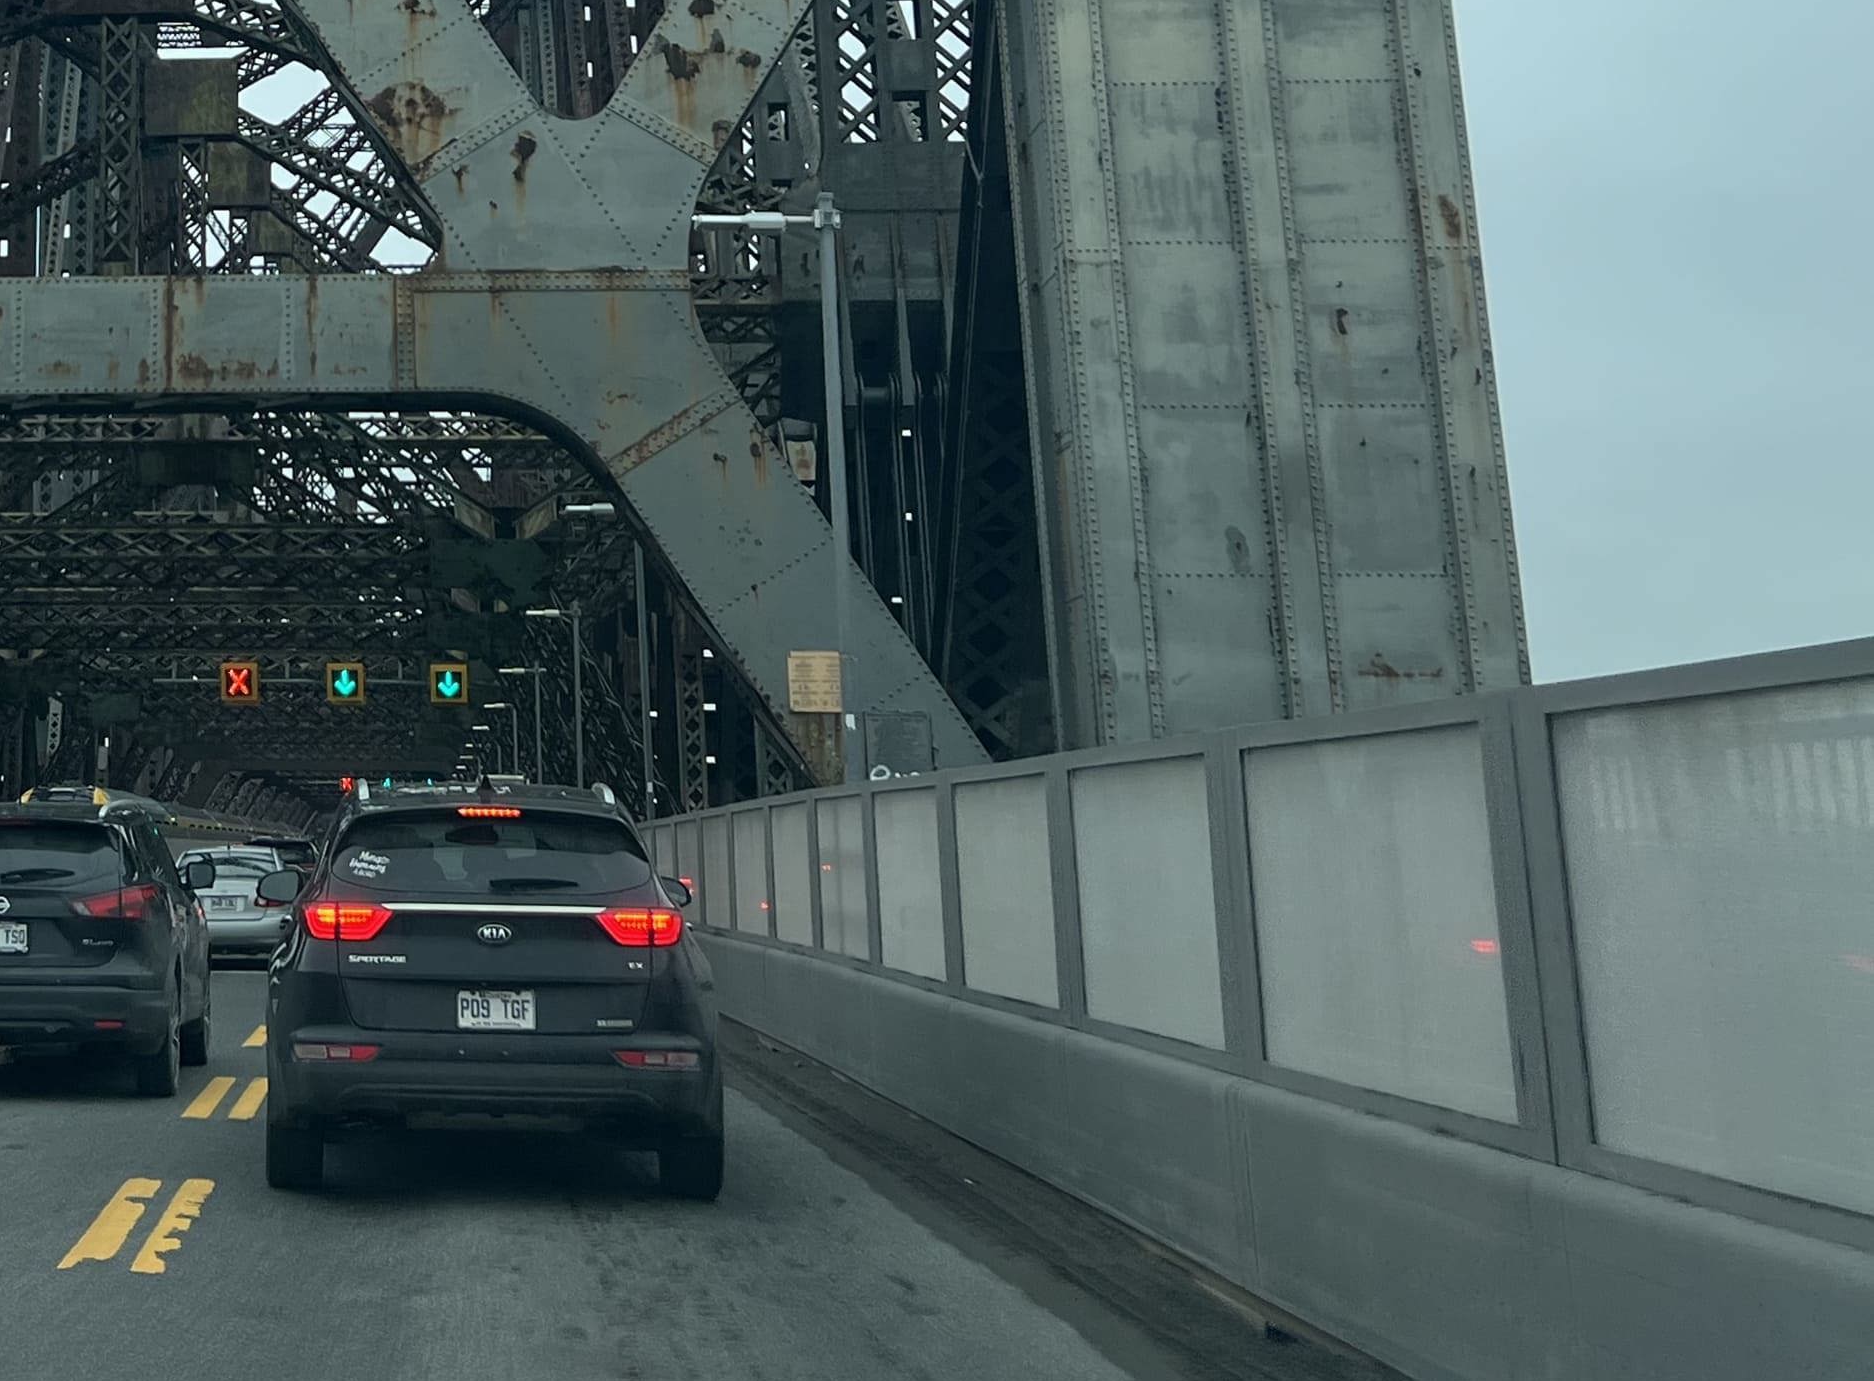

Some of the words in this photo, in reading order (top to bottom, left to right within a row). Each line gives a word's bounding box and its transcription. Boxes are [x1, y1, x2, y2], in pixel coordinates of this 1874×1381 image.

[482, 927, 506, 939] KIA
[348, 954, 407, 964] SPORTAGE
[460, 997, 491, 1019] P09
[501, 998, 530, 1020] TGF
